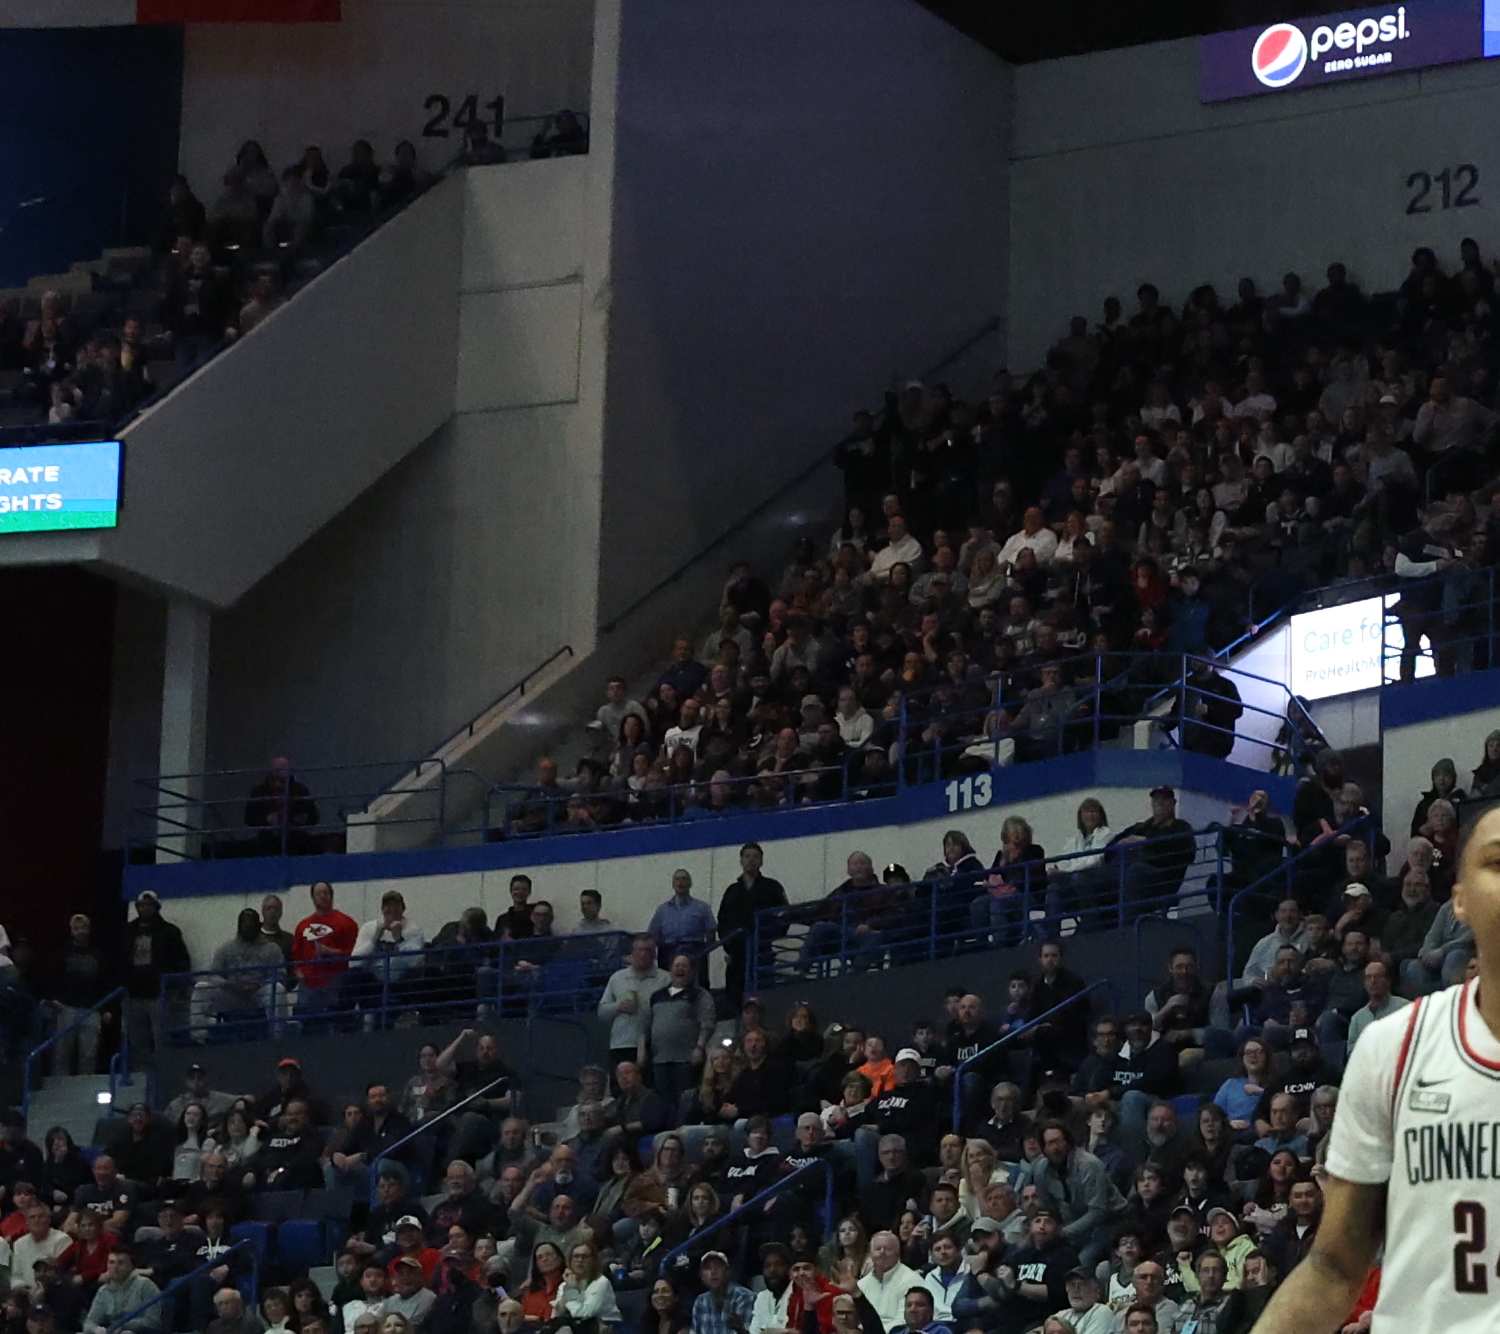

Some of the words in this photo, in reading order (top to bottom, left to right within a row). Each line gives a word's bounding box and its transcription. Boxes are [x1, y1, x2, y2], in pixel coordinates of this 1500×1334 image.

[1324, 54, 1353, 73] ZERO
[1354, 51, 1392, 70] SUGAR
[421, 93, 505, 138] 241
[1405, 163, 1481, 216] 212
[1303, 625, 1355, 654] Care
[944, 772, 994, 813] 113
